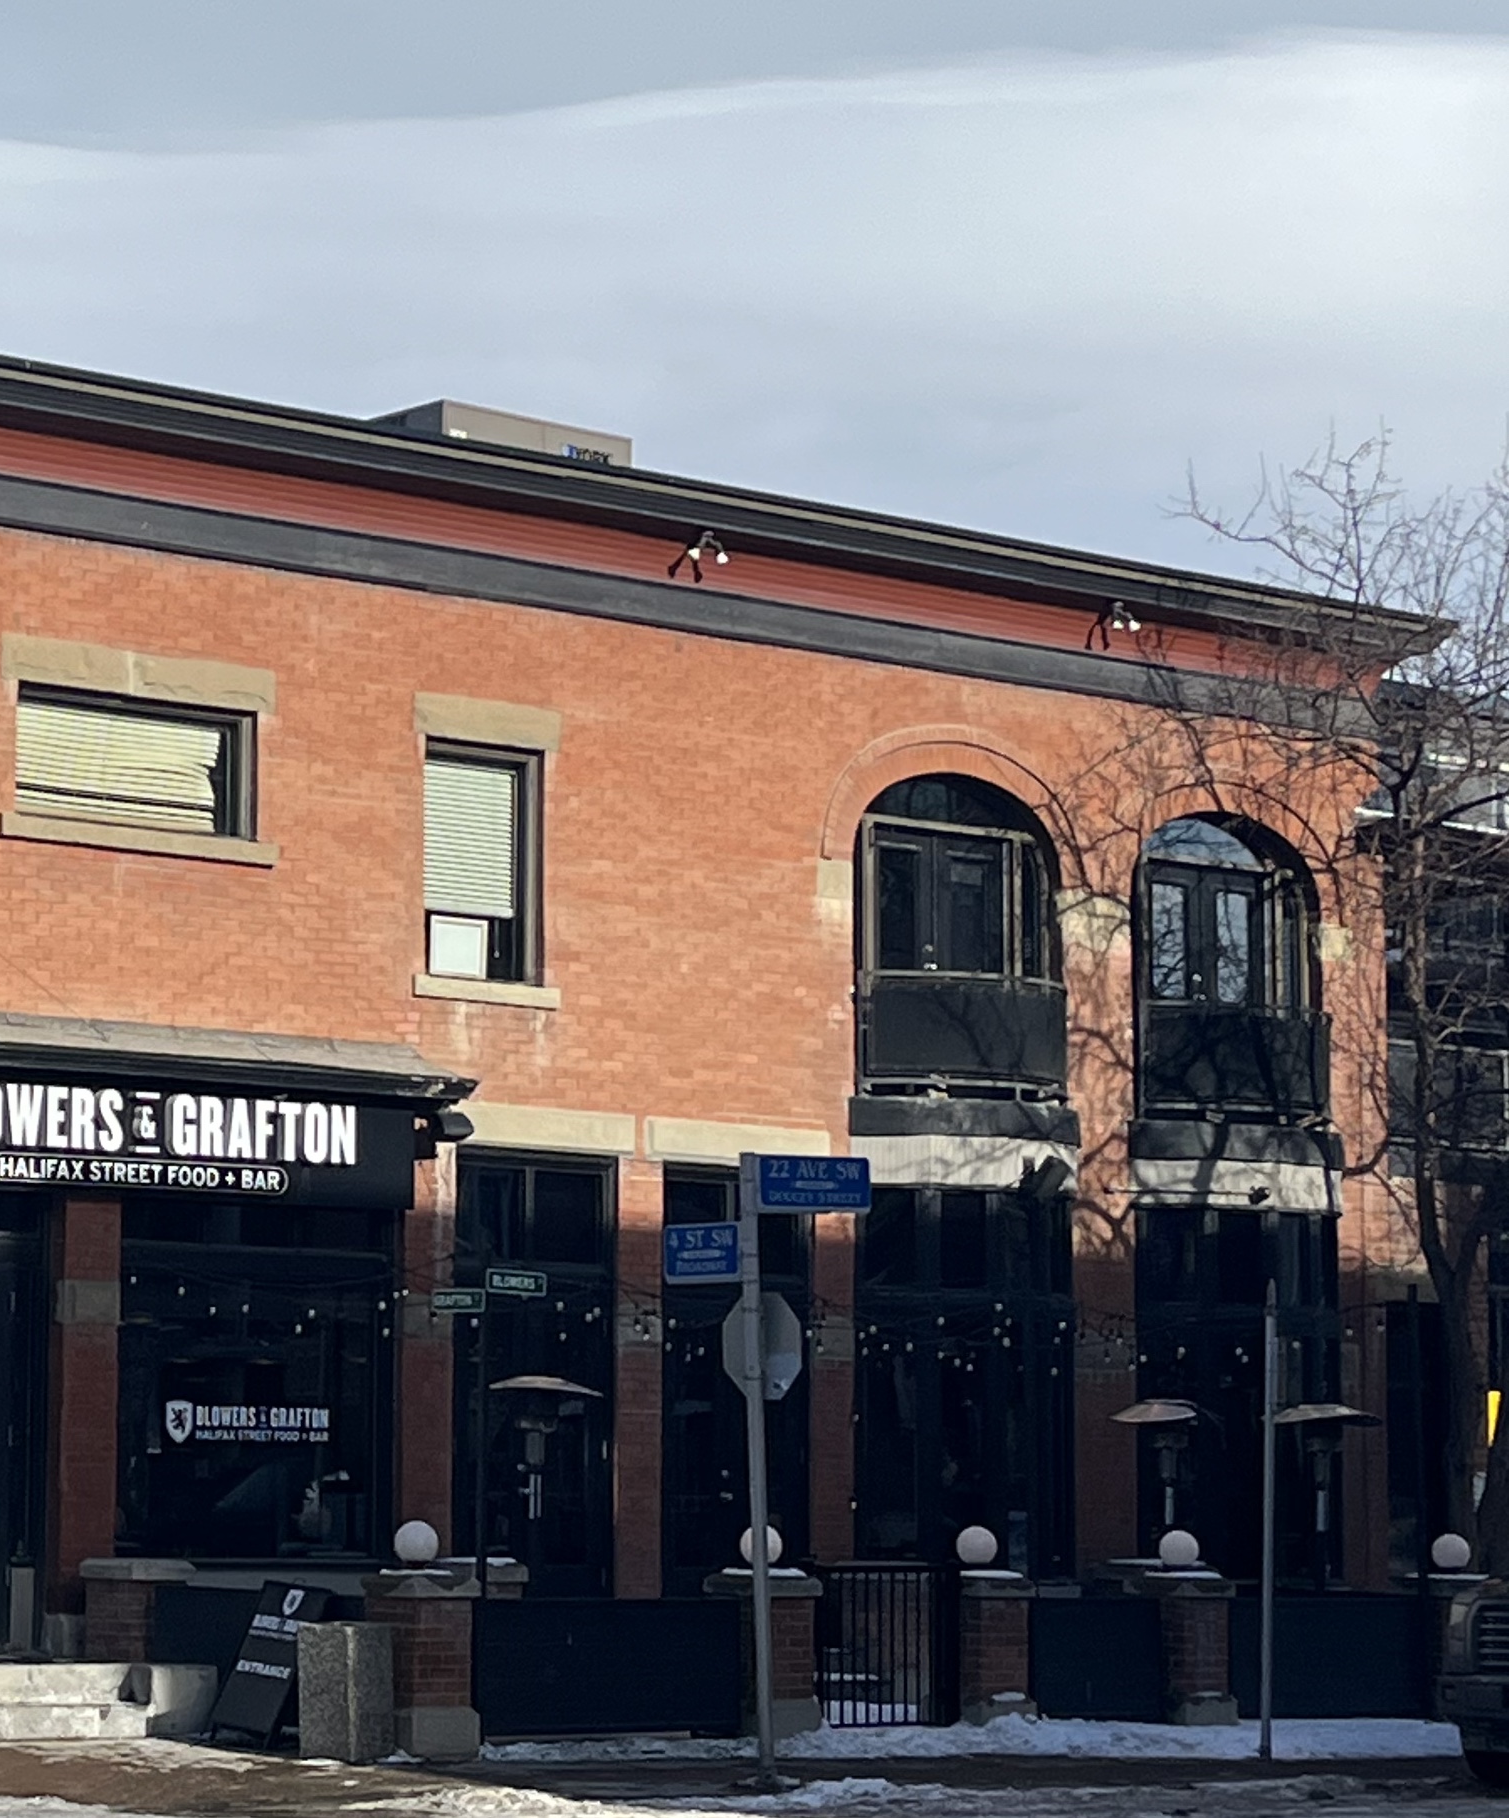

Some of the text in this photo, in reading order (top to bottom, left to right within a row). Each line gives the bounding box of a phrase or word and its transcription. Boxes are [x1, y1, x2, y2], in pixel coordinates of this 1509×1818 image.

[135, 1104, 157, 1140] &
[169, 1094, 357, 1165] GRAFTON
[0, 1156, 84, 1181] HALIFAX
[88, 1161, 163, 1185] STREET
[168, 1165, 220, 1188] FOOD
[241, 1171, 281, 1191] BAR
[768, 1159, 862, 1180] 22 AVE SW
[668, 1227, 734, 1249] 4 ST SW
[196, 1405, 257, 1428] BLOWERS
[269, 1407, 330, 1429] GRAFTON
[195, 1430, 236, 1441] HALIFAX
[274, 1431, 300, 1442] FOOD
[309, 1432, 329, 1443] BAR
